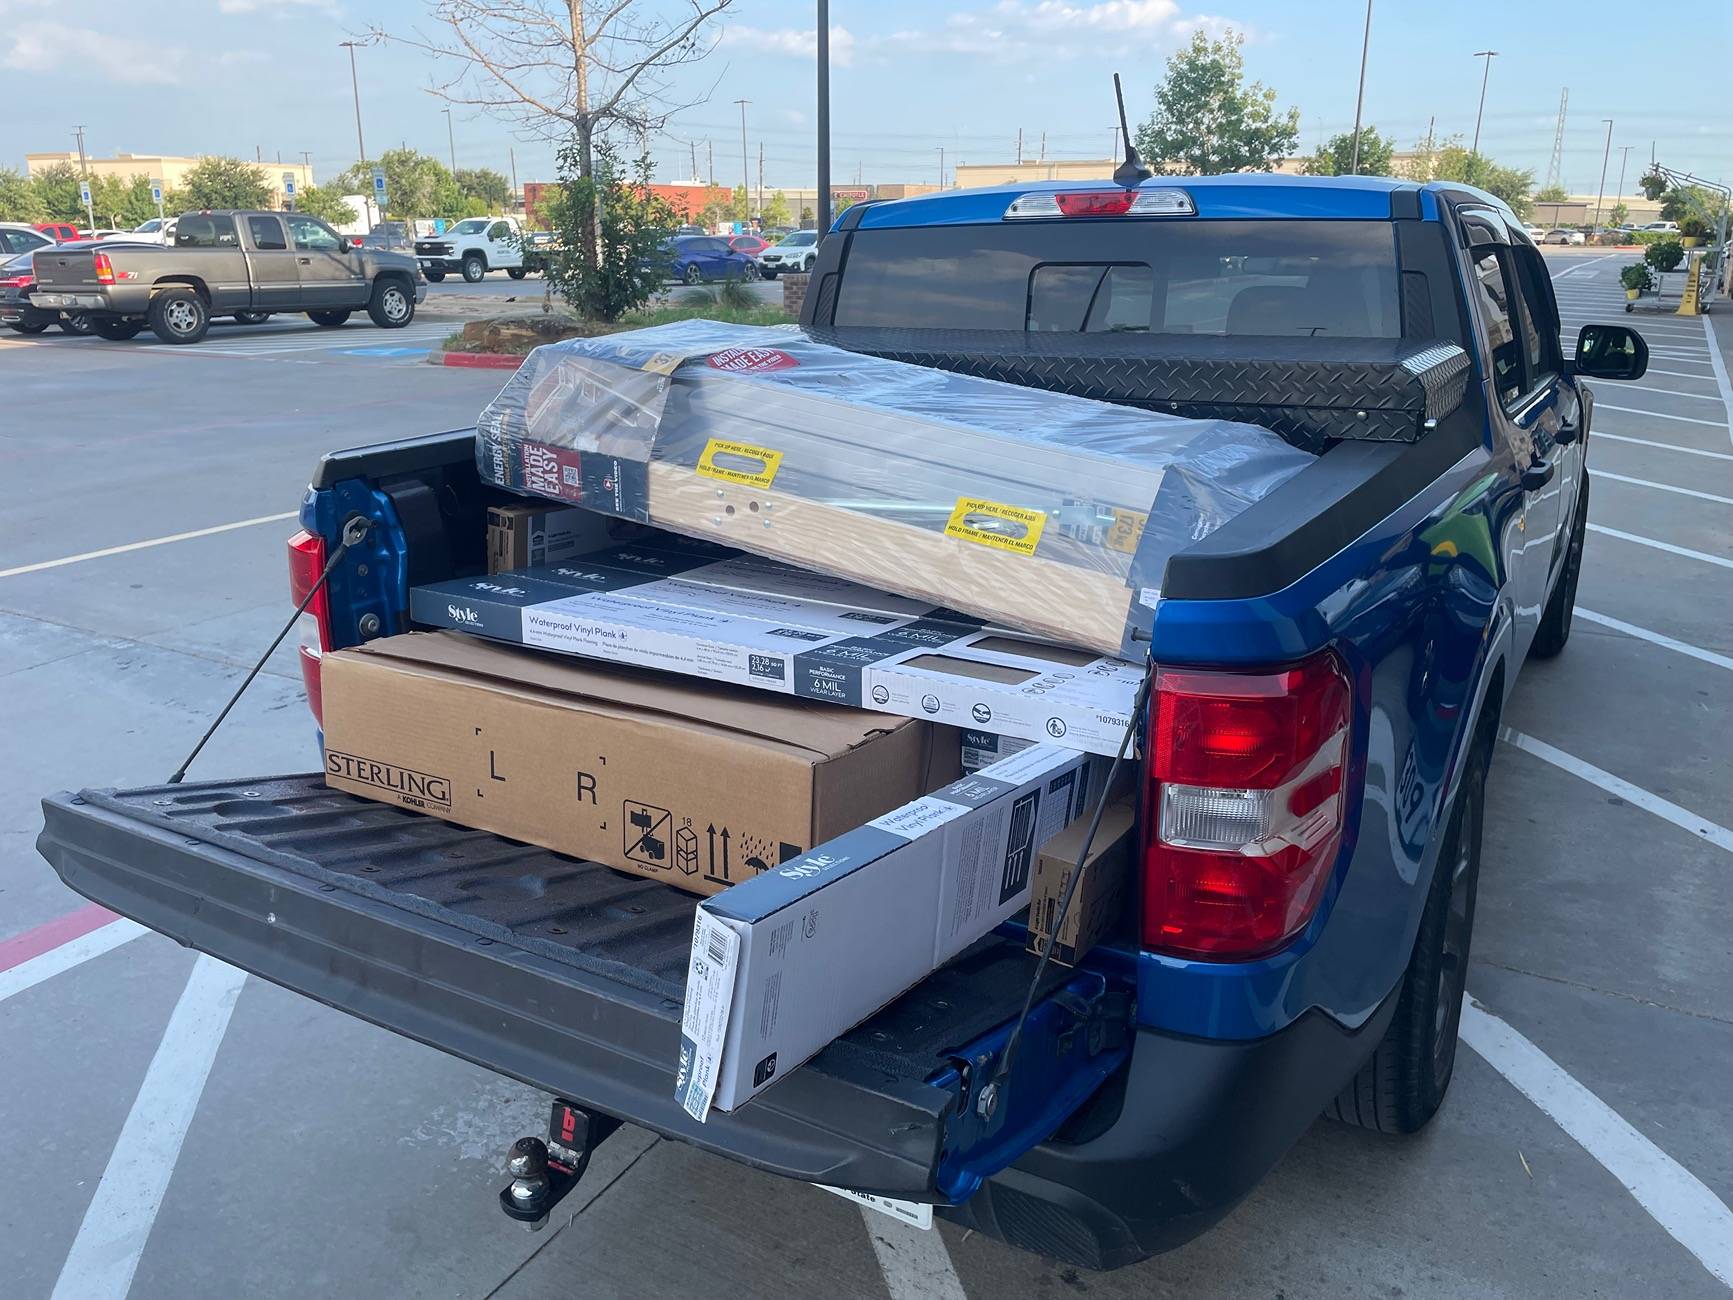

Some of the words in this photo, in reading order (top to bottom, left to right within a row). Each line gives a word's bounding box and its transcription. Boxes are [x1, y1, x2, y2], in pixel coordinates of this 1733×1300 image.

[490, 412, 504, 440] SEAL
[488, 441, 505, 486] ENERGY
[522, 444, 533, 488] INSTALLATION
[529, 446, 545, 491] MADE
[542, 448, 561, 495] EASY
[985, 505, 998, 514] HERE
[961, 526, 979, 538] FRAME
[982, 533, 1009, 545] MANTENER
[1014, 540, 1034, 551] MARCO
[447, 604, 479, 624] Style
[528, 616, 573, 632] Waterproof
[573, 624, 594, 638] Vinyl
[594, 627, 617, 640] Plank
[751, 655, 770, 666] 23.28
[819, 666, 834, 674] BASIC
[808, 668, 846, 681] PERFORMANCE
[814, 679, 820, 688] 6
[822, 680, 841, 692] MIL
[810, 687, 828, 696] WEAR
[827, 689, 846, 698] LAYER
[328, 753, 446, 801] STERLING
[490, 750, 505, 782] L
[577, 771, 598, 805] R
[402, 795, 425, 808] KOHLER
[426, 802, 451, 814] COMPANY
[682, 817, 692, 827] 18
[779, 854, 836, 880] Style
[676, 1047, 689, 1091] Style
